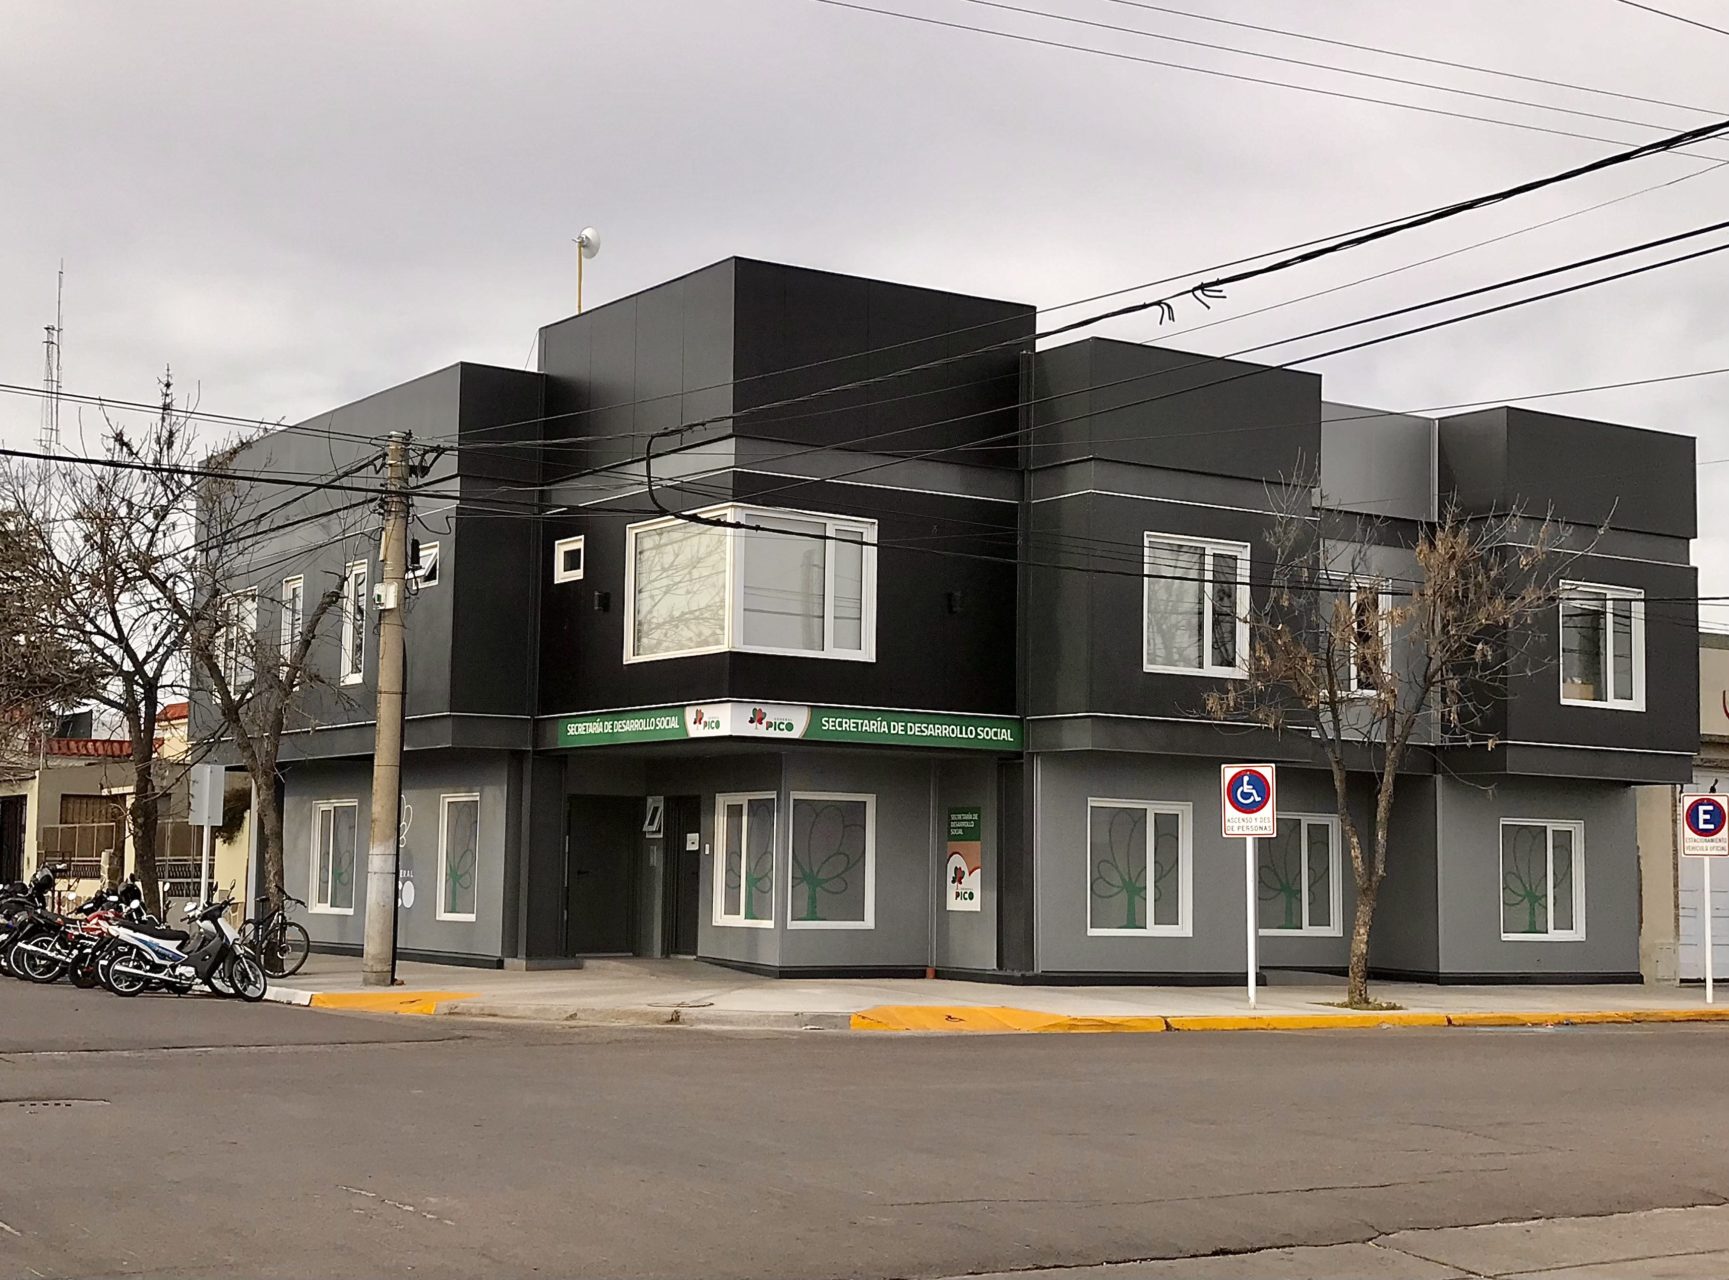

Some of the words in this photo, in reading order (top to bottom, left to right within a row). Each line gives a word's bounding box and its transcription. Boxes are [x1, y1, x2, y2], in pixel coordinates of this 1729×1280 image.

[567, 719, 603, 735] SECRETARÍA
[604, 721, 613, 733] DE
[613, 718, 655, 732] DESARROLLO
[655, 716, 680, 729] SOCIAL
[703, 720, 721, 730] PICO
[766, 720, 794, 732] PICO
[821, 717, 889, 733] SECRETARÍA
[890, 722, 905, 735] DE
[907, 723, 976, 739] DESARROLLO
[977, 727, 1014, 741] SOCIAL
[1227, 816, 1253, 824] ASCENSO
[1698, 805, 1715, 830] E
[400, 869, 414, 878] ERAL
[955, 891, 975, 901] PICO
